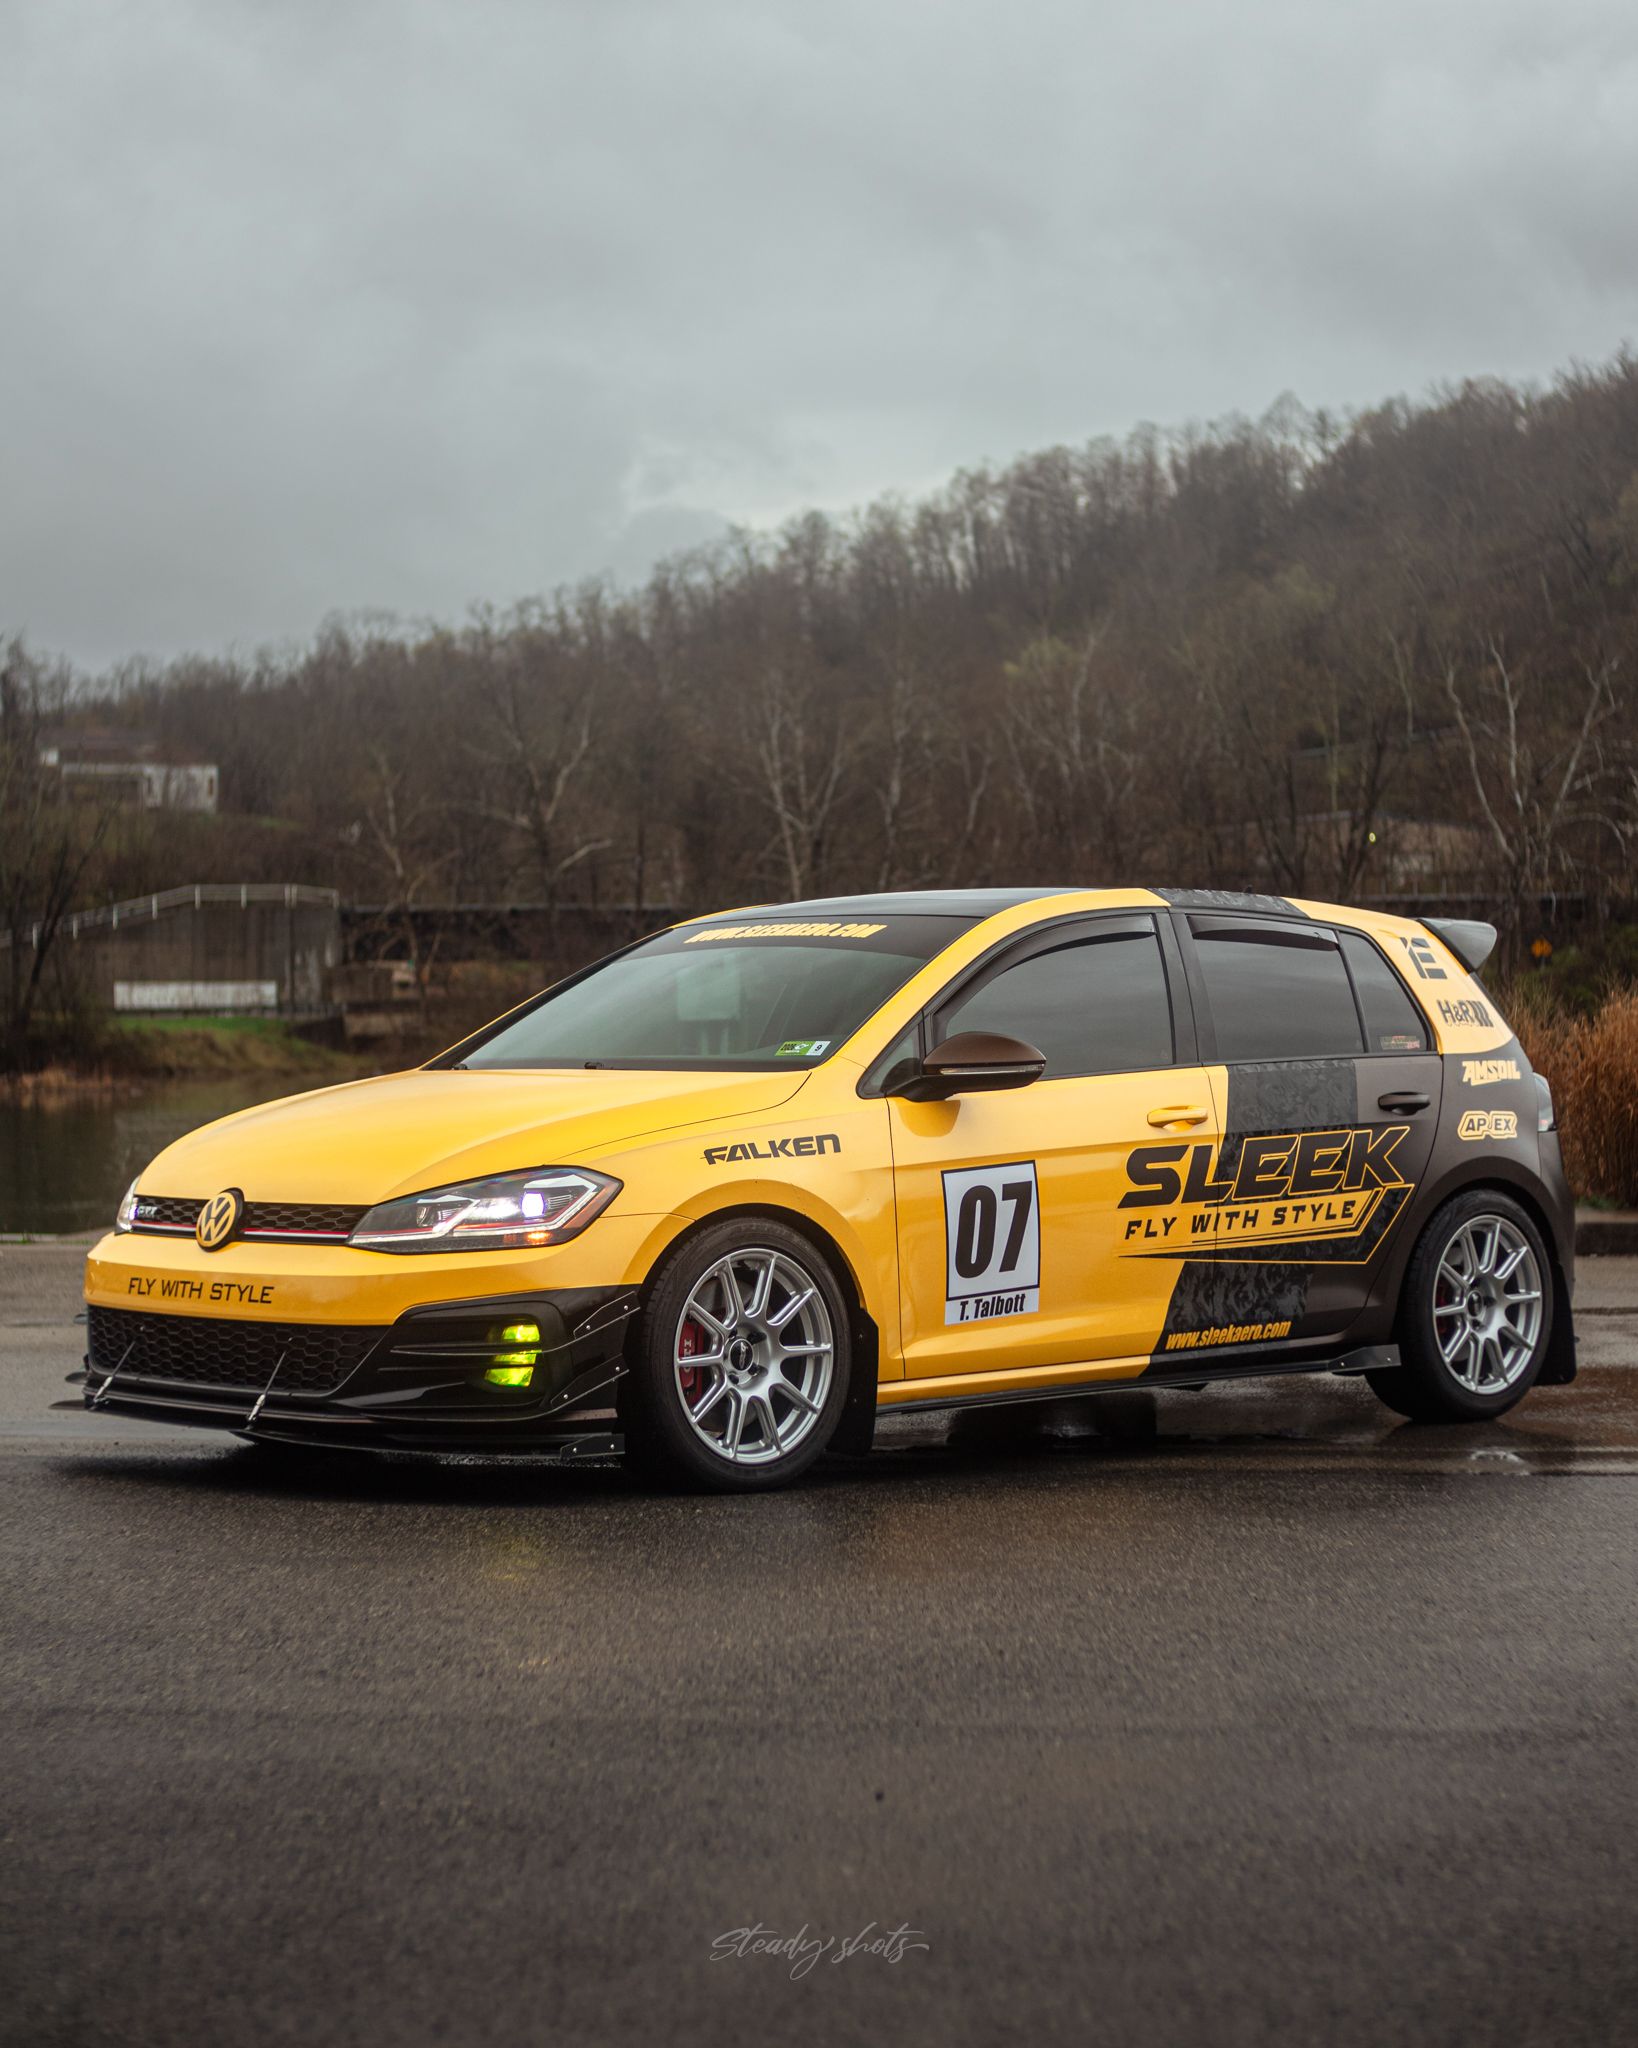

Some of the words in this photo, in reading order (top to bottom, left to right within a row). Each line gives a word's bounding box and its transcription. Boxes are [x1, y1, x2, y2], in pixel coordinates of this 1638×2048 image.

[1437, 999, 1475, 1024] H&R
[1462, 1060, 1520, 1086] AMSOIL
[703, 1133, 842, 1165] FALKEN
[1117, 1125, 1411, 1209] SLEEK
[954, 1180, 1033, 1279] 07
[1124, 1217, 1177, 1240] FLY
[1191, 1209, 1259, 1234] WITH
[1272, 1200, 1356, 1226] STYLE
[128, 1277, 156, 1295] FLY
[161, 1279, 203, 1299] WITH
[210, 1283, 275, 1304] STYLE
[960, 1301, 970, 1321] T.
[973, 1293, 1026, 1319] Talbott
[1165, 1321, 1291, 1350] www.sleekaero.com
